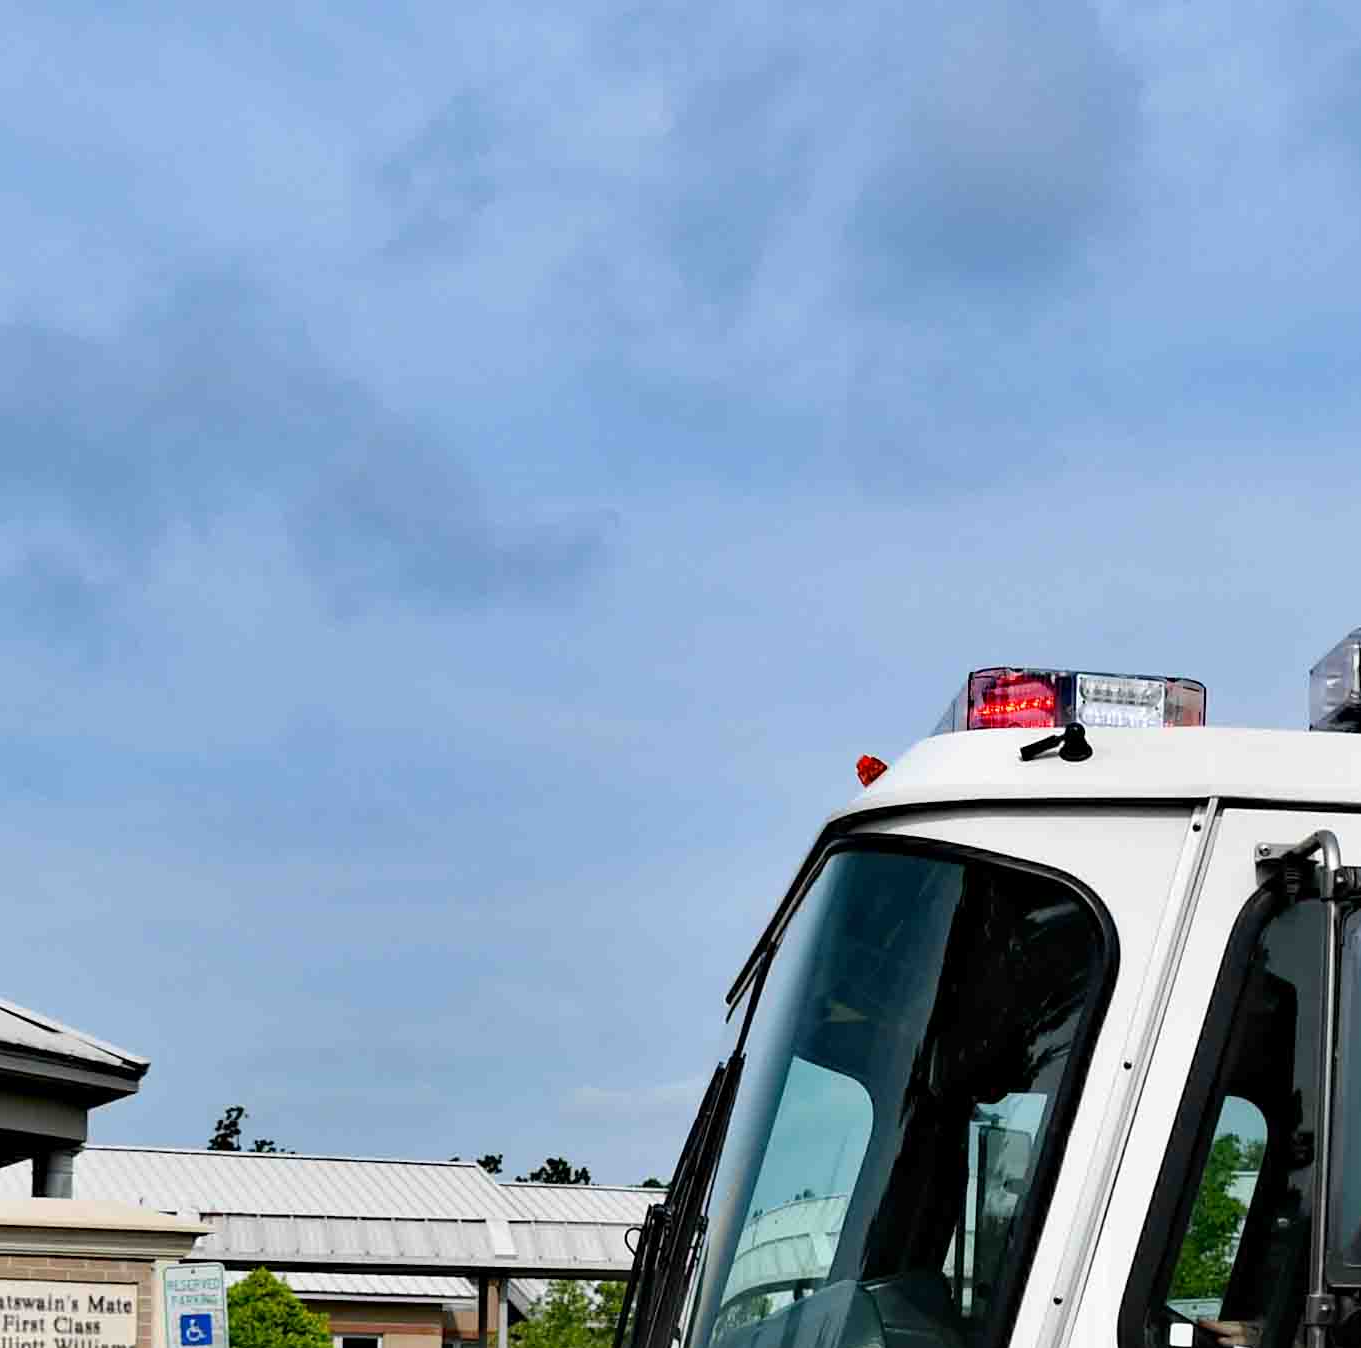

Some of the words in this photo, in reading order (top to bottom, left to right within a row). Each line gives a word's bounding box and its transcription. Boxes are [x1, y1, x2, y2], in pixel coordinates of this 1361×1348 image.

[87, 1295, 133, 1314] Mate
[2, 1314, 45, 1333] First
[53, 1316, 101, 1335] Class
